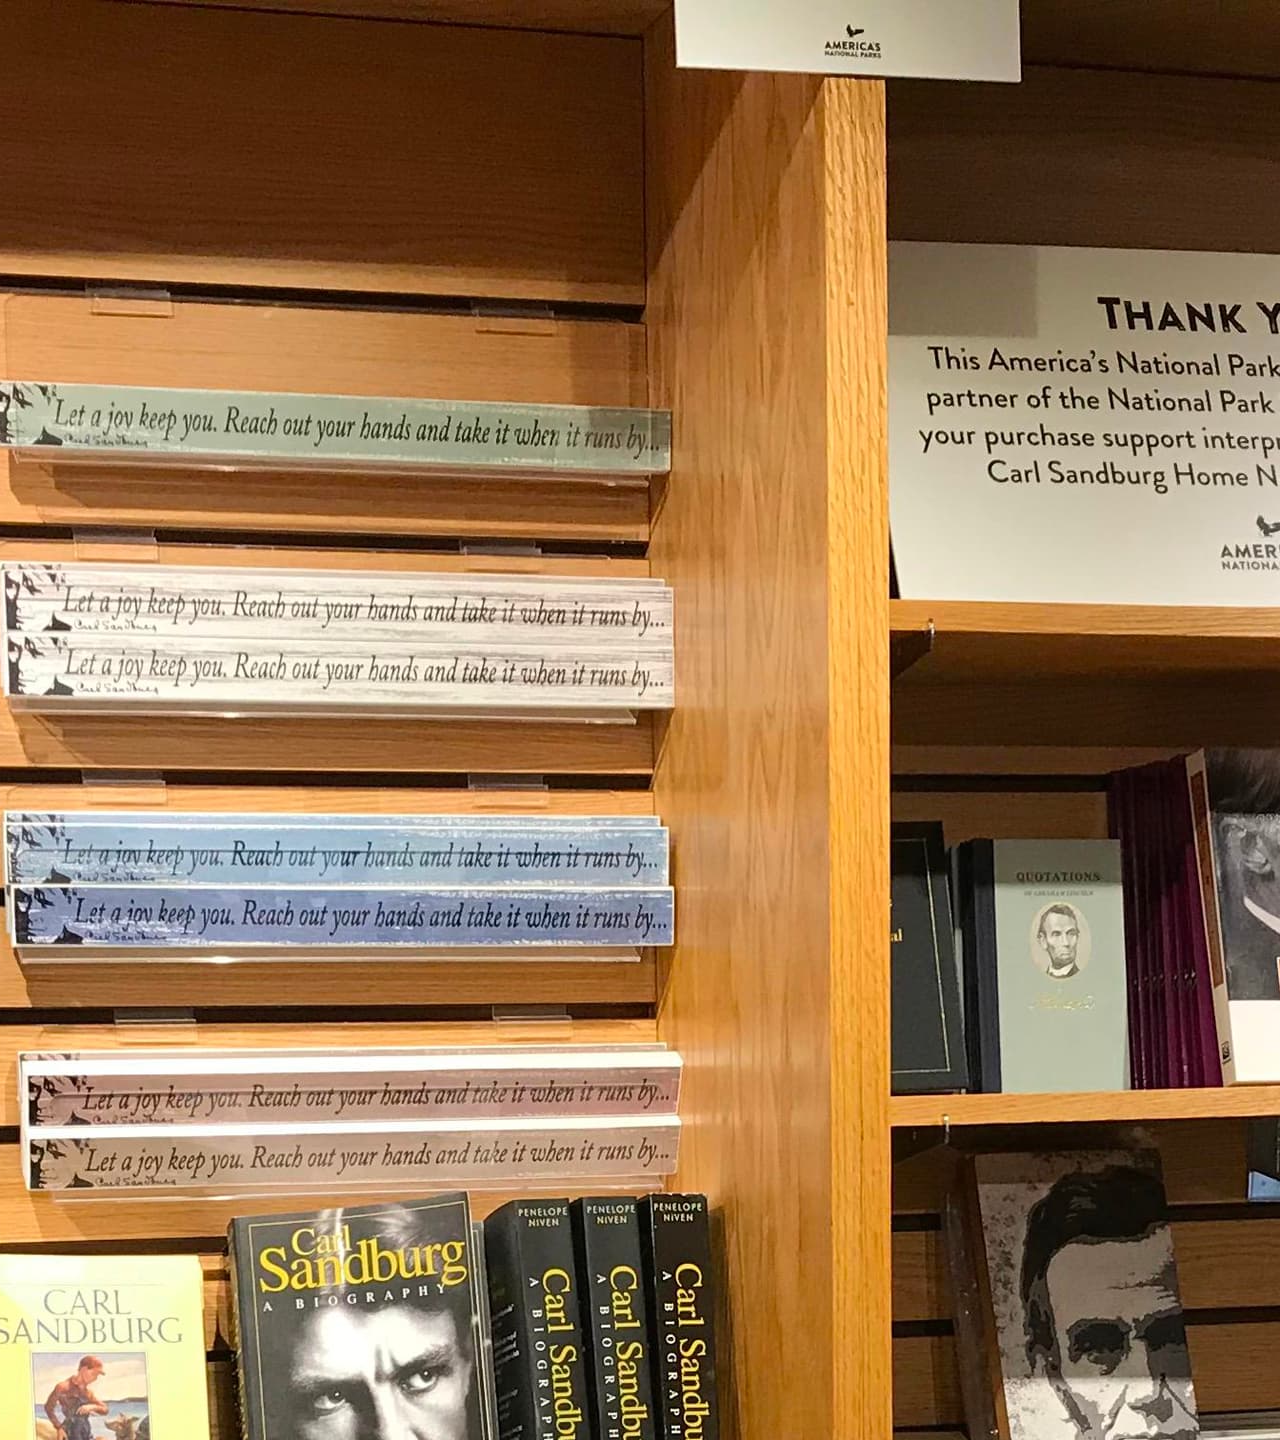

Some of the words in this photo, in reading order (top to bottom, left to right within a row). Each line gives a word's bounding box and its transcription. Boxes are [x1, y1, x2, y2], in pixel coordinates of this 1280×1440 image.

[825, 41, 881, 52] AMERICA'S
[1098, 296, 1246, 334] THANK
[928, 346, 980, 371] This
[1118, 352, 1220, 378] National
[927, 389, 1017, 415] partner
[1027, 387, 1051, 411] of
[1059, 388, 1099, 411] the
[1109, 389, 1212, 414] National
[1221, 391, 1271, 416] Park
[919, 427, 975, 454] your
[985, 426, 1094, 455] purchase
[1103, 430, 1194, 457] support
[988, 459, 1040, 484] Carl
[1048, 460, 1166, 492] Sandburg
[1174, 465, 1248, 489] Home
[1017, 872, 1100, 882] QUOTATIONS
[85, 1148, 117, 1172] Let
[121, 1158, 133, 1171] a
[134, 1156, 162, 1178] joy
[169, 1150, 205, 1176] keep
[210, 1156, 244, 1176] you.
[251, 1147, 302, 1169] Reach
[307, 1150, 335, 1167] out
[339, 1153, 377, 1175] your
[382, 1143, 430, 1166] hands
[437, 1143, 467, 1165] and
[472, 1143, 507, 1165] take
[511, 1143, 526, 1163] it
[530, 1141, 575, 1162] when
[580, 1141, 594, 1161] it
[598, 1145, 632, 1161] runs
[636, 1138, 669, 1165] by...
[653, 1202, 702, 1212] PENELOPE
[664, 1212, 693, 1222] NIVEN
[292, 1225, 351, 1255] Carl
[259, 1238, 467, 1292] Sandburg
[43, 1290, 131, 1316] CARL
[263, 1301, 272, 1312] A
[296, 1283, 449, 1310] BIOGRAPHY
[675, 1263, 705, 1328] Carl
